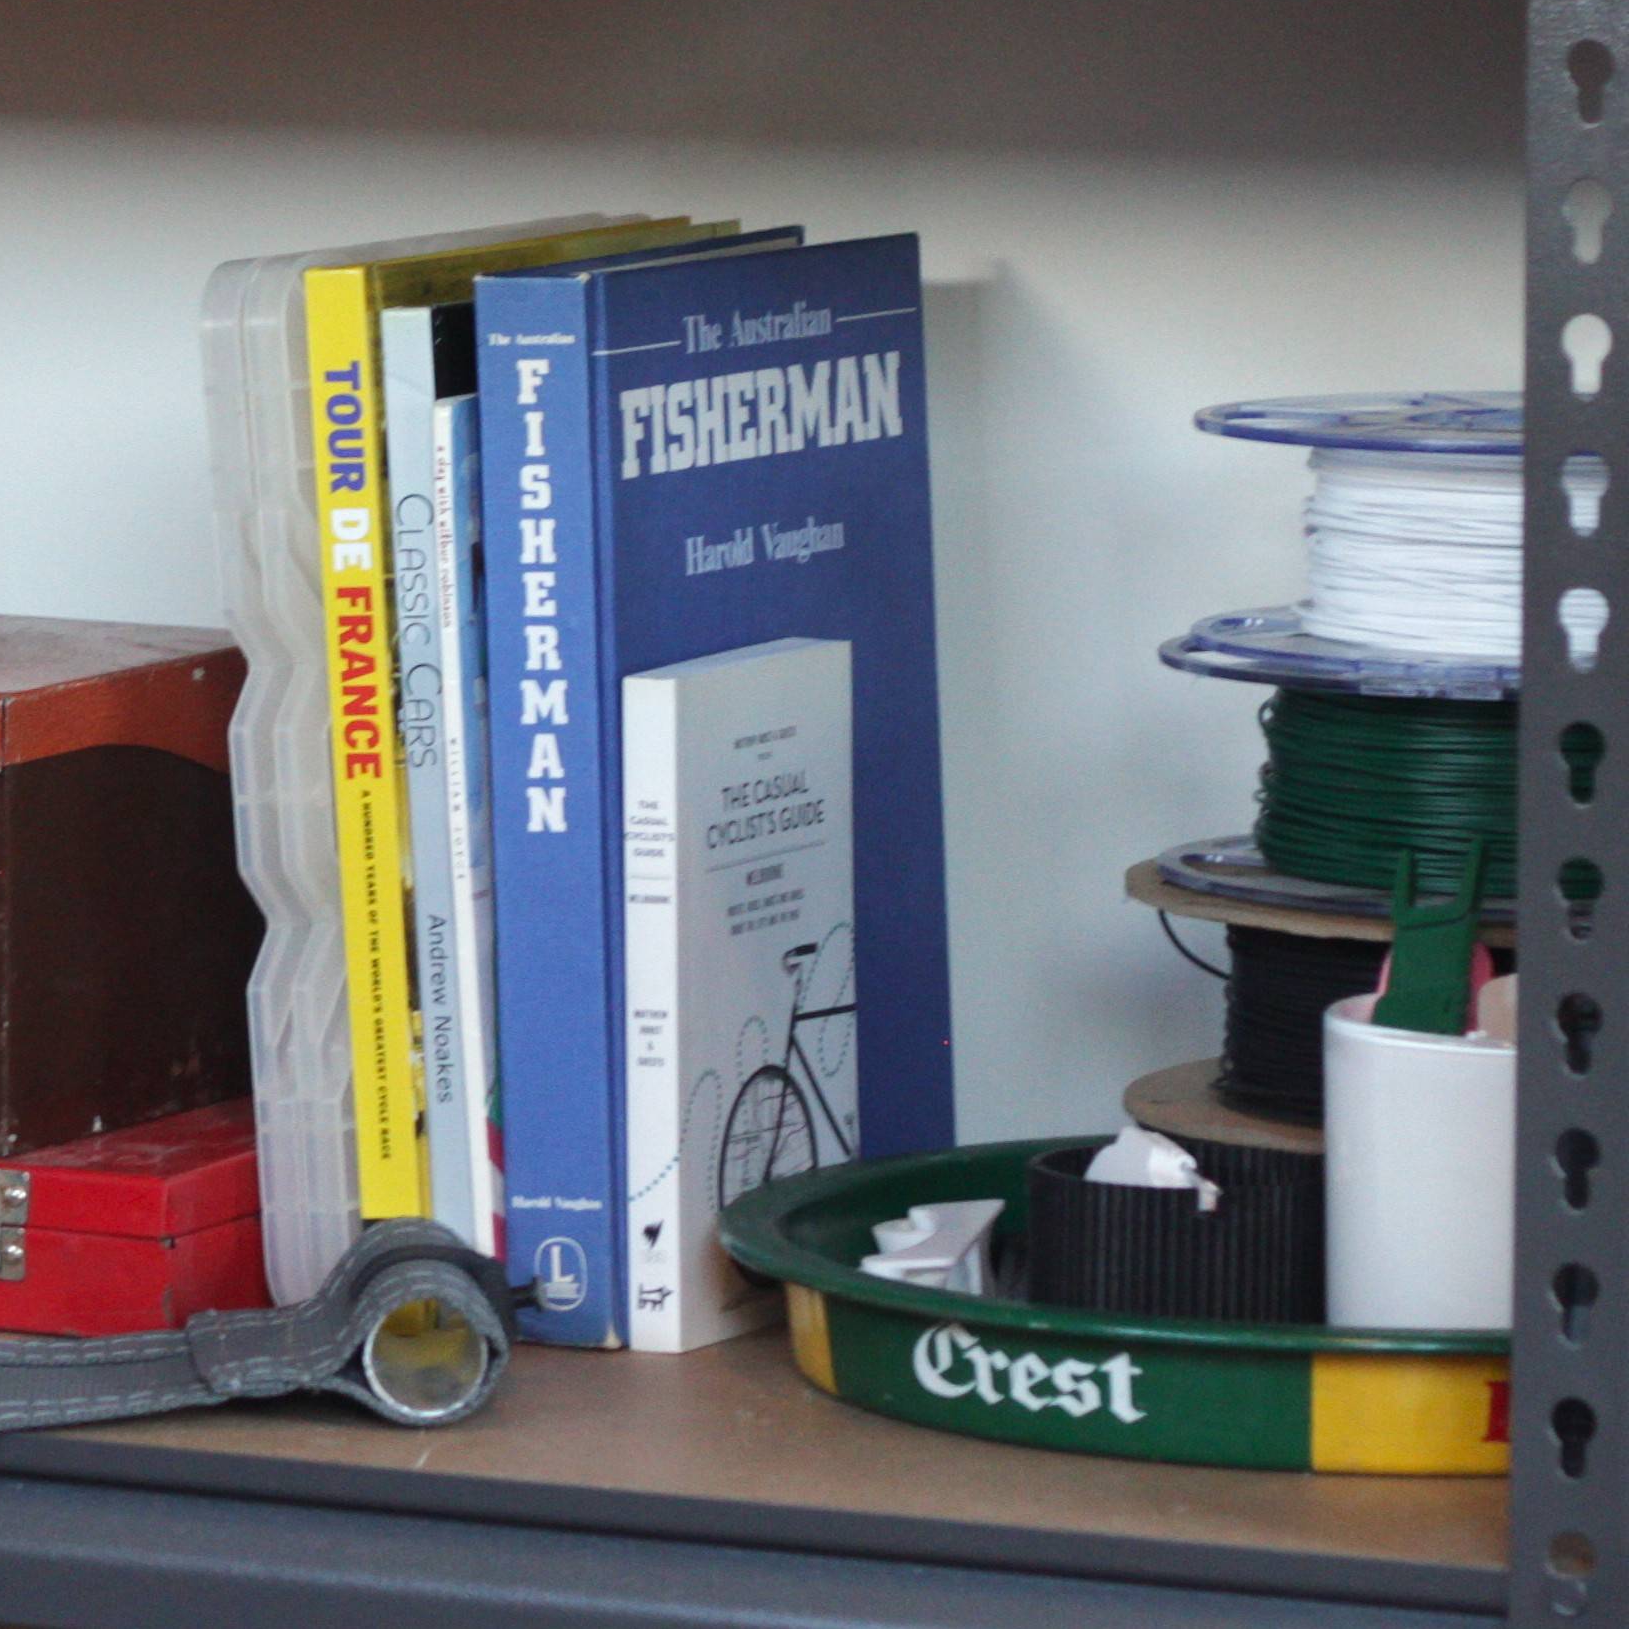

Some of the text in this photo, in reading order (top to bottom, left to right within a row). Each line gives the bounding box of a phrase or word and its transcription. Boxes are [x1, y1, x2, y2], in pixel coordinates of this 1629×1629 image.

[488, 332, 512, 346] The
[684, 300, 832, 354] The Australian
[620, 350, 903, 480] FISHERMAN
[438, 486, 453, 515] with
[325, 360, 382, 780] TOUR DE FRANCE
[685, 515, 845, 576] Harold Vaughan
[516, 358, 569, 833] FISHERMAN
[396, 493, 443, 769] CLASSIC CARS
[722, 769, 809, 812] THE CASUAL
[779, 798, 826, 833] GUIDE
[362, 802, 375, 860] HUNDRED
[366, 864, 377, 905] YEARS
[368, 909, 379, 925] OF
[369, 930, 381, 954] THE
[371, 958, 384, 1013] WORLD'S
[427, 913, 454, 1105] Andrew Noakes
[374, 1018, 388, 1080] GREATEST
[378, 1085, 389, 1123] CYCLE
[380, 1127, 392, 1160] RACE
[511, 1195, 552, 1209] Harold
[913, 1323, 1148, 1424] Crest
